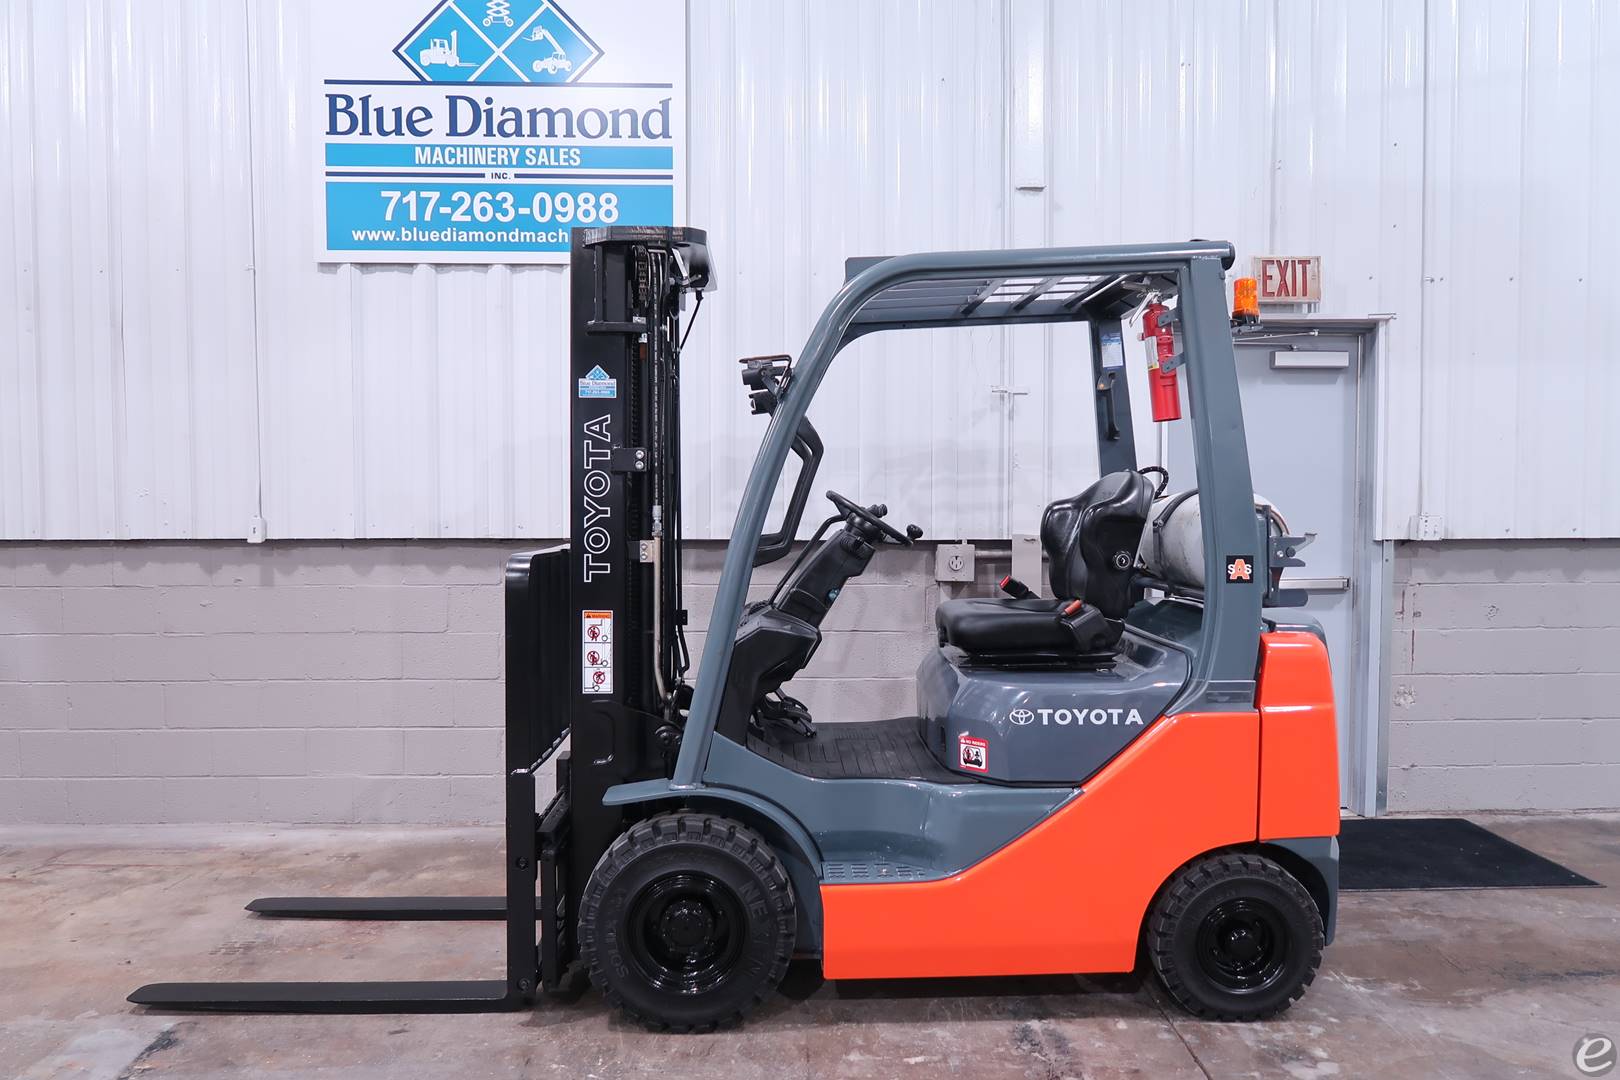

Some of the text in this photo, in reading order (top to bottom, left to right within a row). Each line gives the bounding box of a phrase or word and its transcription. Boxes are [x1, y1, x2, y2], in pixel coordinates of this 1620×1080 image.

[325, 93, 673, 140] Blue Diamond
[415, 147, 581, 166] MACHINERY SALES
[490, 172, 512, 181] INC.
[380, 190, 620, 224] 717-263-0988
[1262, 259, 1312, 297] EXIT
[584, 414, 611, 582] TOYOTA
[1037, 708, 1143, 725] TOYOTA
